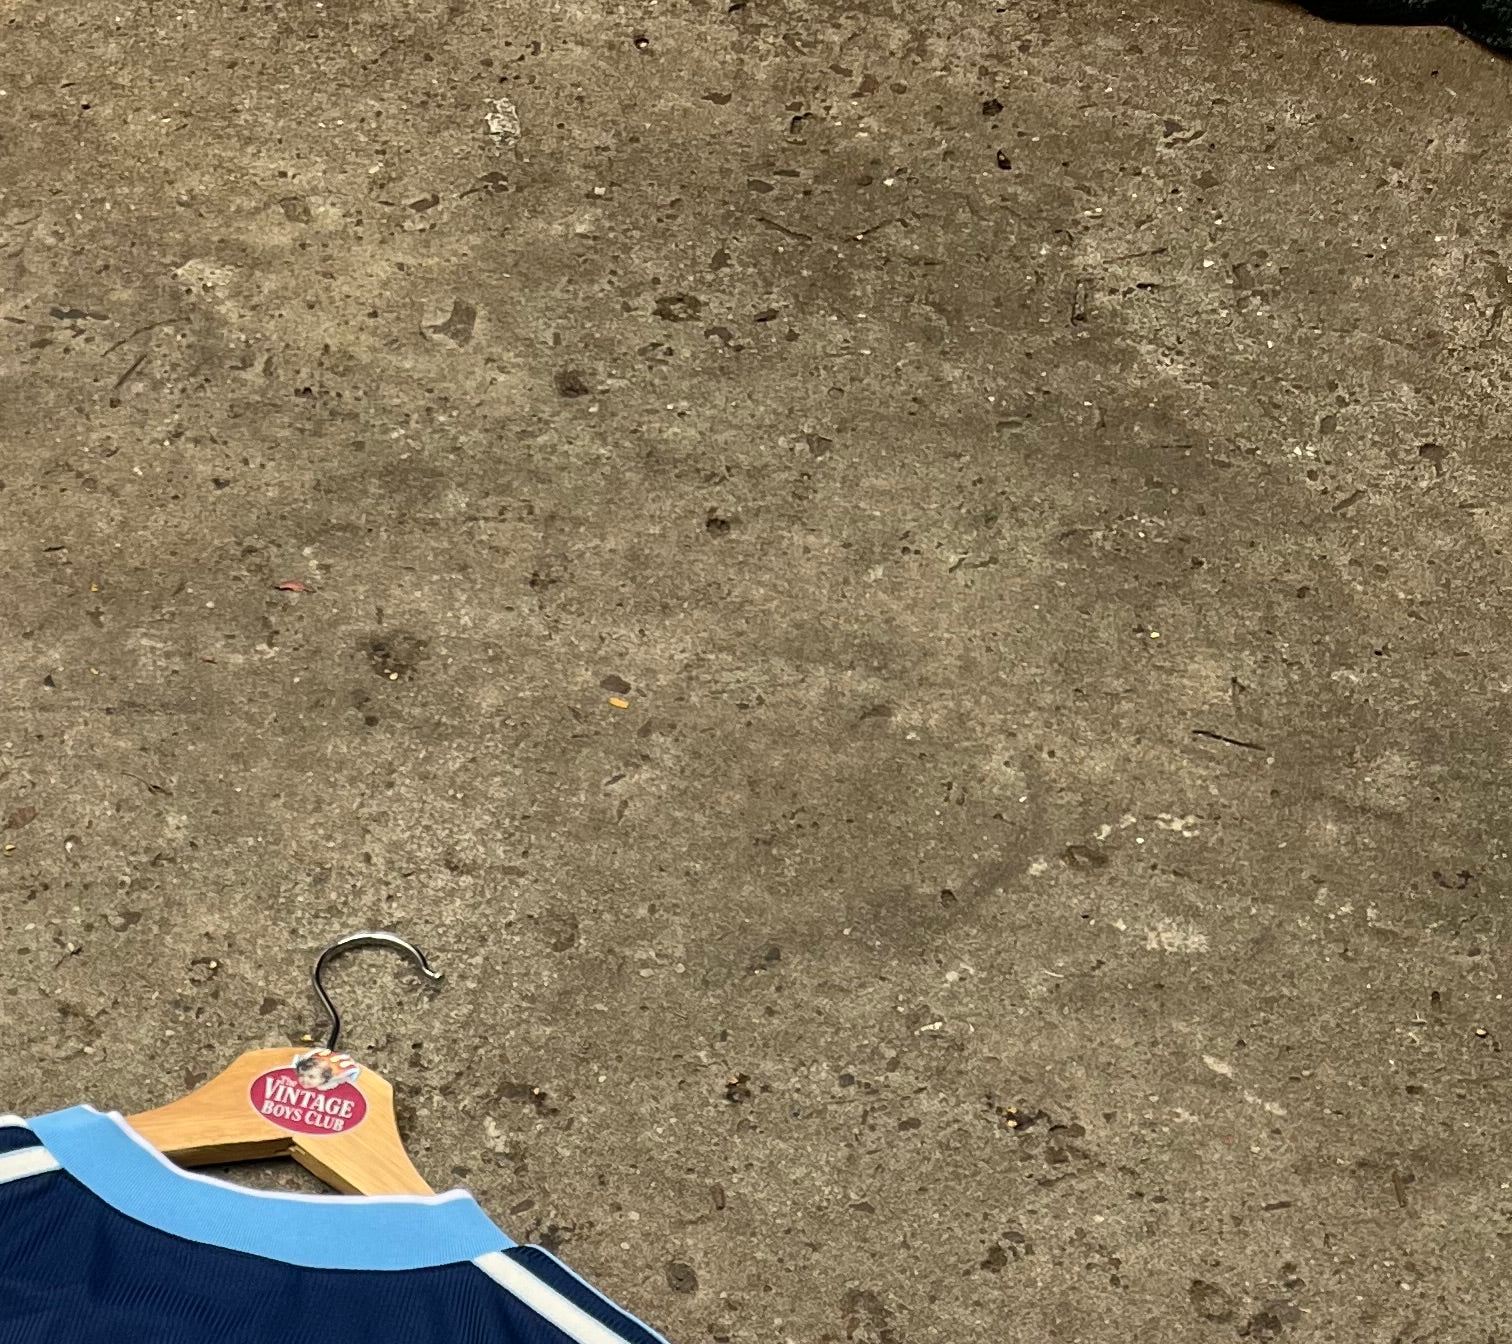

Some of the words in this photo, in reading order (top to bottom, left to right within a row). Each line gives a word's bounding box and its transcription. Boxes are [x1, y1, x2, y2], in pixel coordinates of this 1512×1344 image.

[263, 1077, 355, 1118] VINTAGE
[261, 1100, 303, 1122] BOYS
[304, 1110, 345, 1132] CLUB
